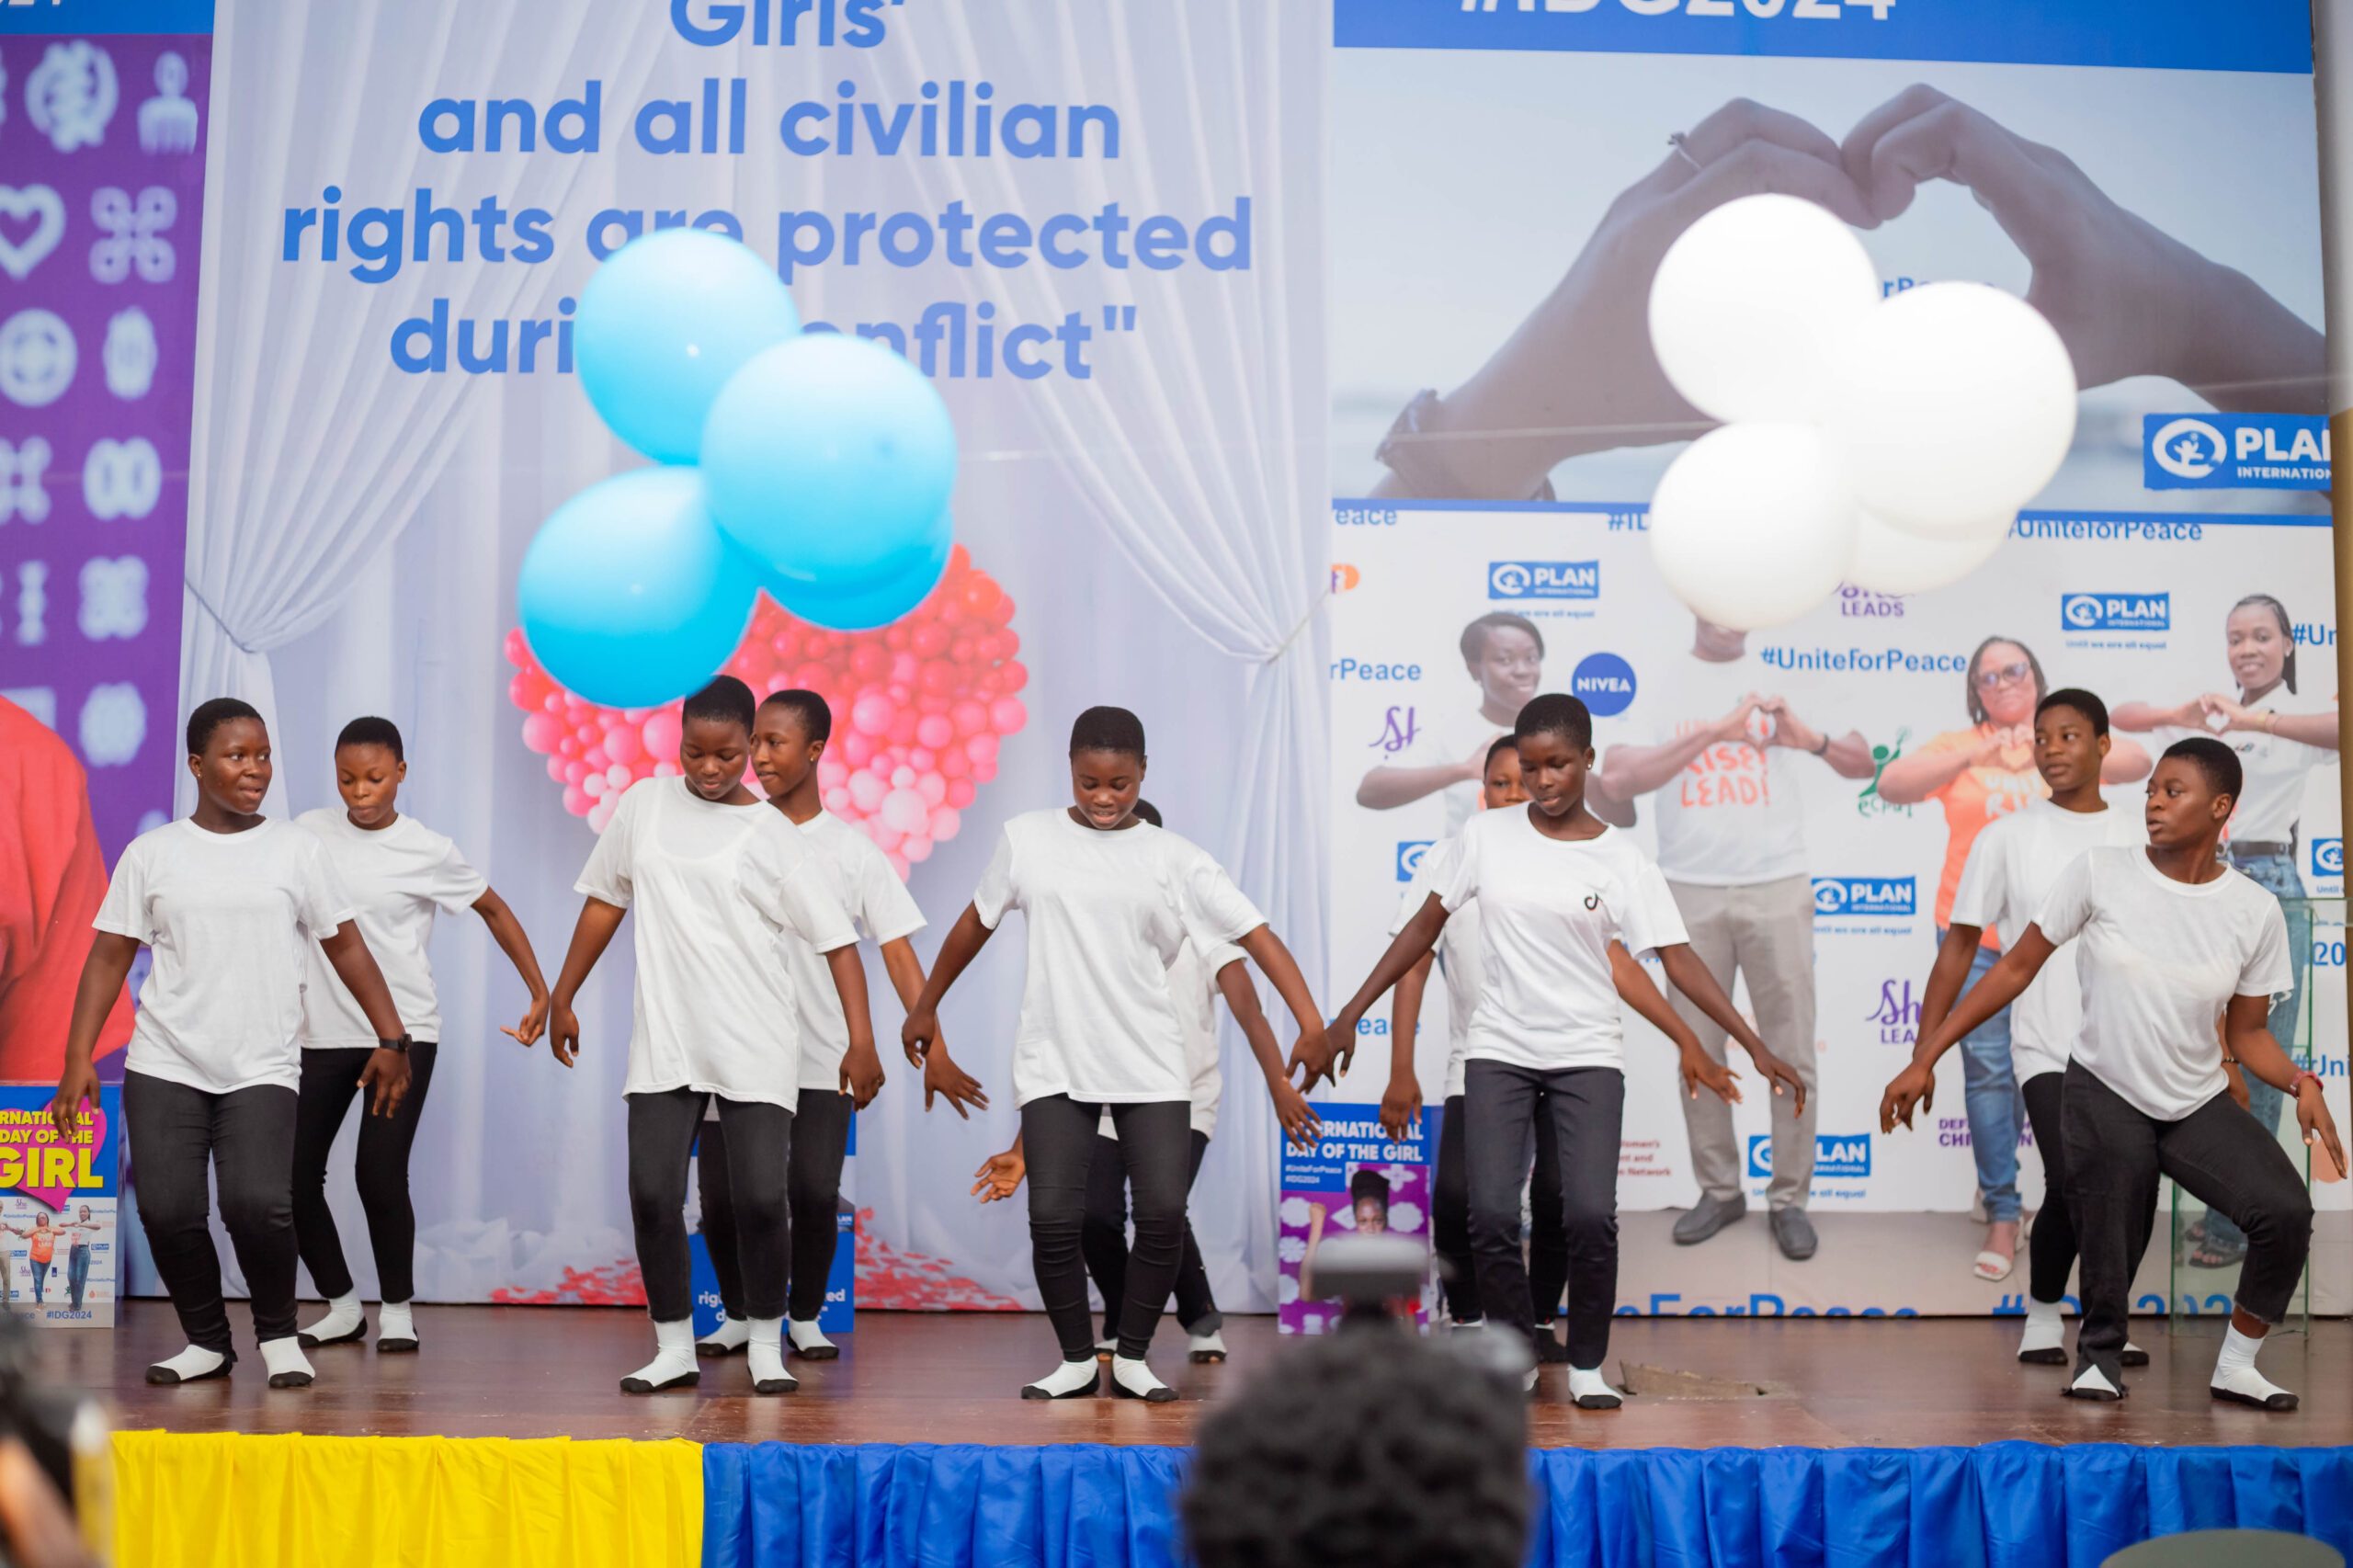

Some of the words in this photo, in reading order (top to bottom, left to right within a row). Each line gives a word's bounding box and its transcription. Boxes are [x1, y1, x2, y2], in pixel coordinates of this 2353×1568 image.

[418, 79, 602, 154] and
[634, 77, 747, 155] all
[779, 79, 1120, 159] civilian
[282, 185, 554, 284] rights
[778, 197, 1250, 286] protected
[391, 296, 576, 375] duri
[1534, 568, 1596, 586] PLAN
[1842, 601, 1904, 618] LEADS
[2107, 599, 2166, 619] PLAN
[1577, 677, 1631, 692] NIVEA
[1851, 883, 1911, 903] PLAN
[1865, 978, 1923, 1026] Sh
[1881, 1028, 1916, 1044] LEA
[35, 1130, 59, 1144] OF
[68, 1130, 94, 1144] HE
[1322, 1142, 1345, 1159] OF
[1347, 1143, 1379, 1160] THE
[1382, 1144, 1423, 1162] GIRL
[1815, 1142, 1867, 1163] LAN
[0, 1146, 104, 1187] GIRL
